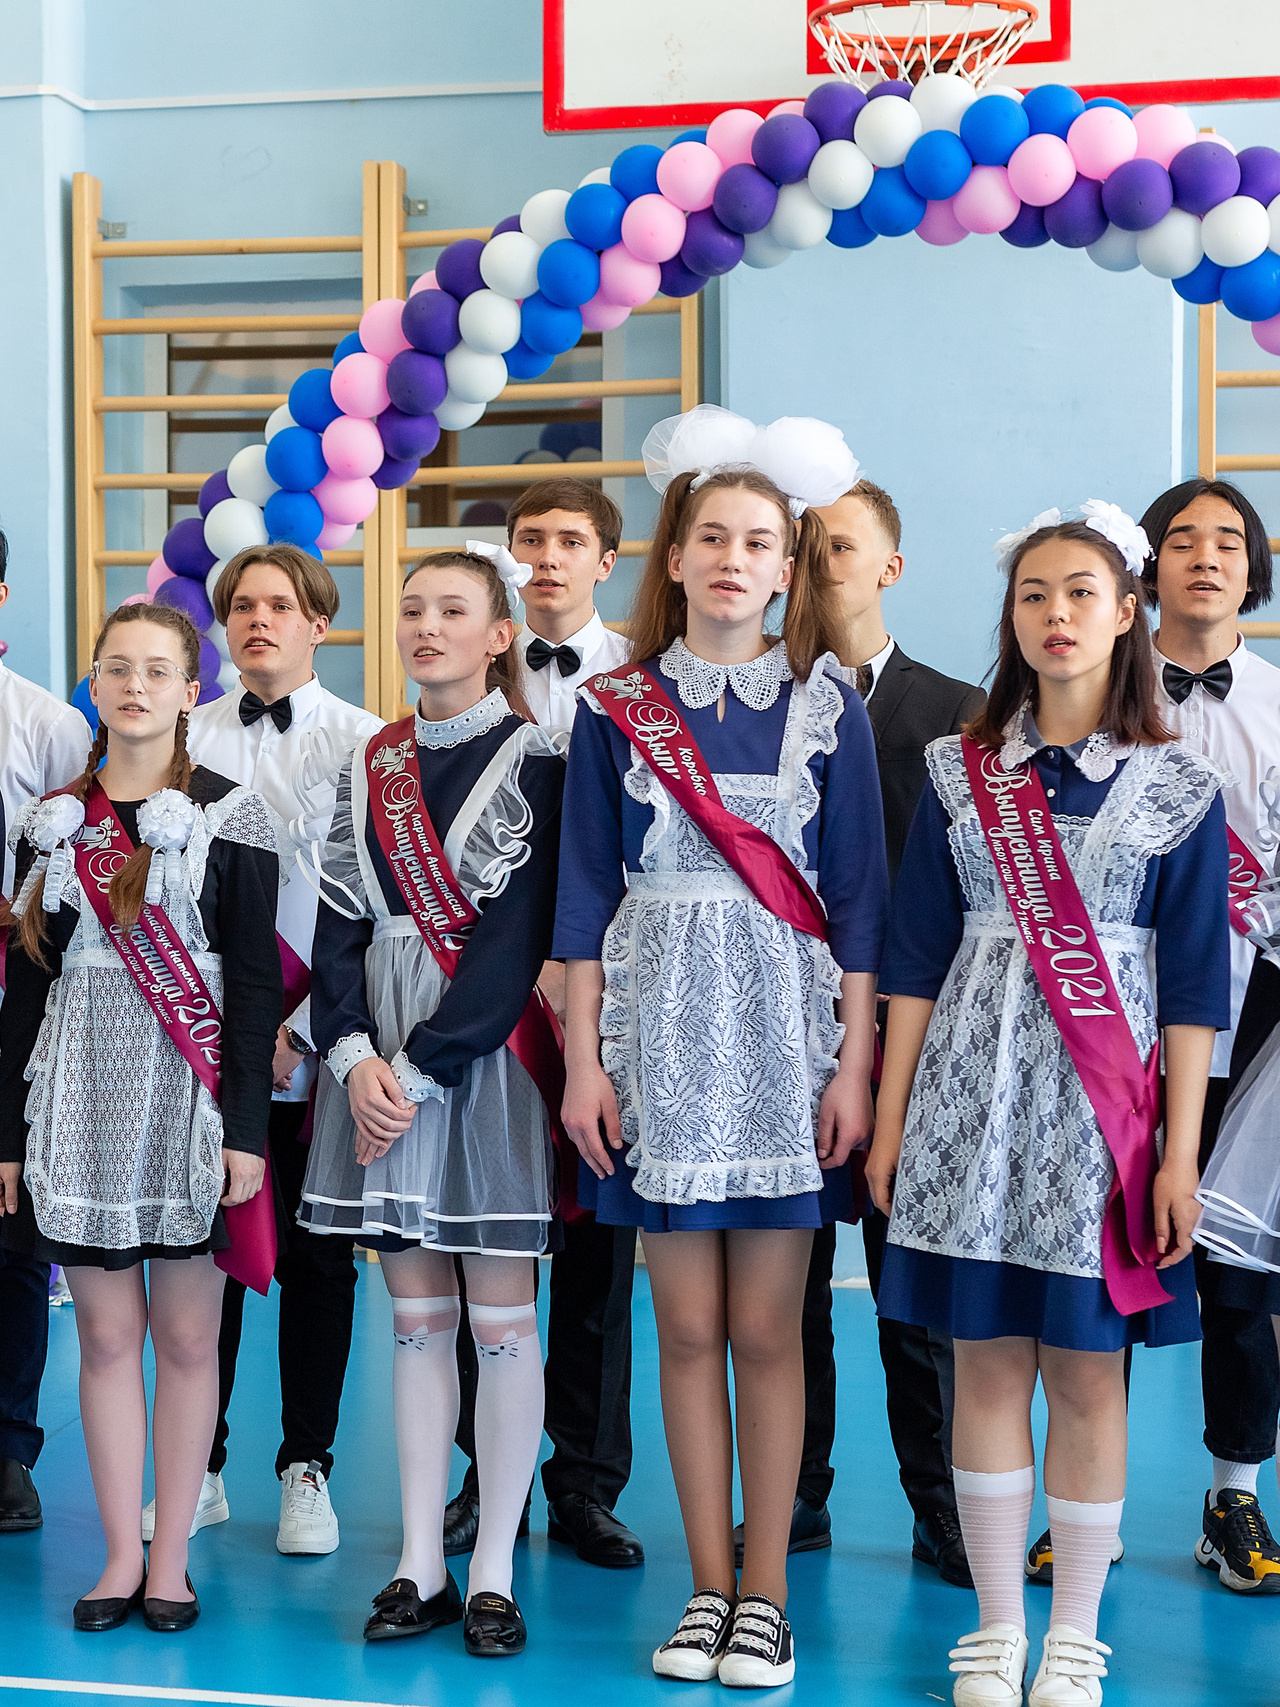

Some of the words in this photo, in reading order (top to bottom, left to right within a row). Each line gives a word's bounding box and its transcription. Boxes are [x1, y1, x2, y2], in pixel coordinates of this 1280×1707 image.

[381, 772, 451, 931] Выпускница
[411, 813, 432, 854] Ларина
[426, 855, 467, 919] Анастасия
[991, 839, 1009, 863] МБОУ
[1000, 863, 1015, 883] СОШ
[1027, 808, 1045, 836] Сим
[1037, 837, 1062, 882] Ирина
[392, 861, 407, 882] МБОУ
[402, 882, 415, 899] СОШ
[980, 750, 1055, 924] Выпускница
[1038, 924, 1117, 1018] 2021
[127, 955, 143, 973] СОШ
[168, 949, 201, 995] Наталья
